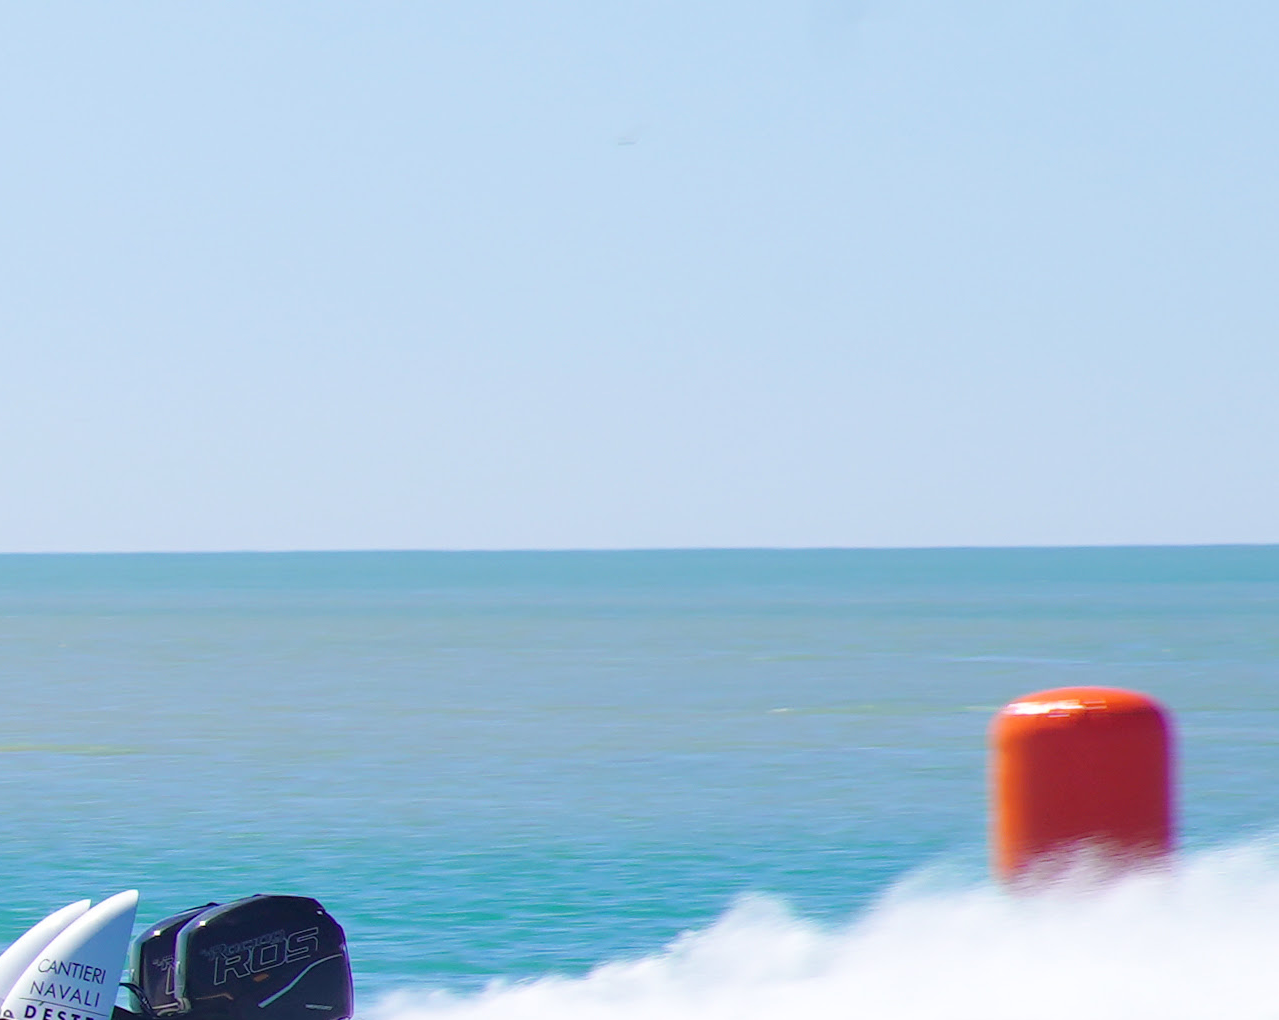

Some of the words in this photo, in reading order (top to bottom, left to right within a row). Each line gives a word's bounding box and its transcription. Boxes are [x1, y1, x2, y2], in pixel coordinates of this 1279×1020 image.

[213, 926, 319, 986] ROS
[37, 958, 107, 985] CANTIERI
[29, 980, 101, 1008] NAVALI
